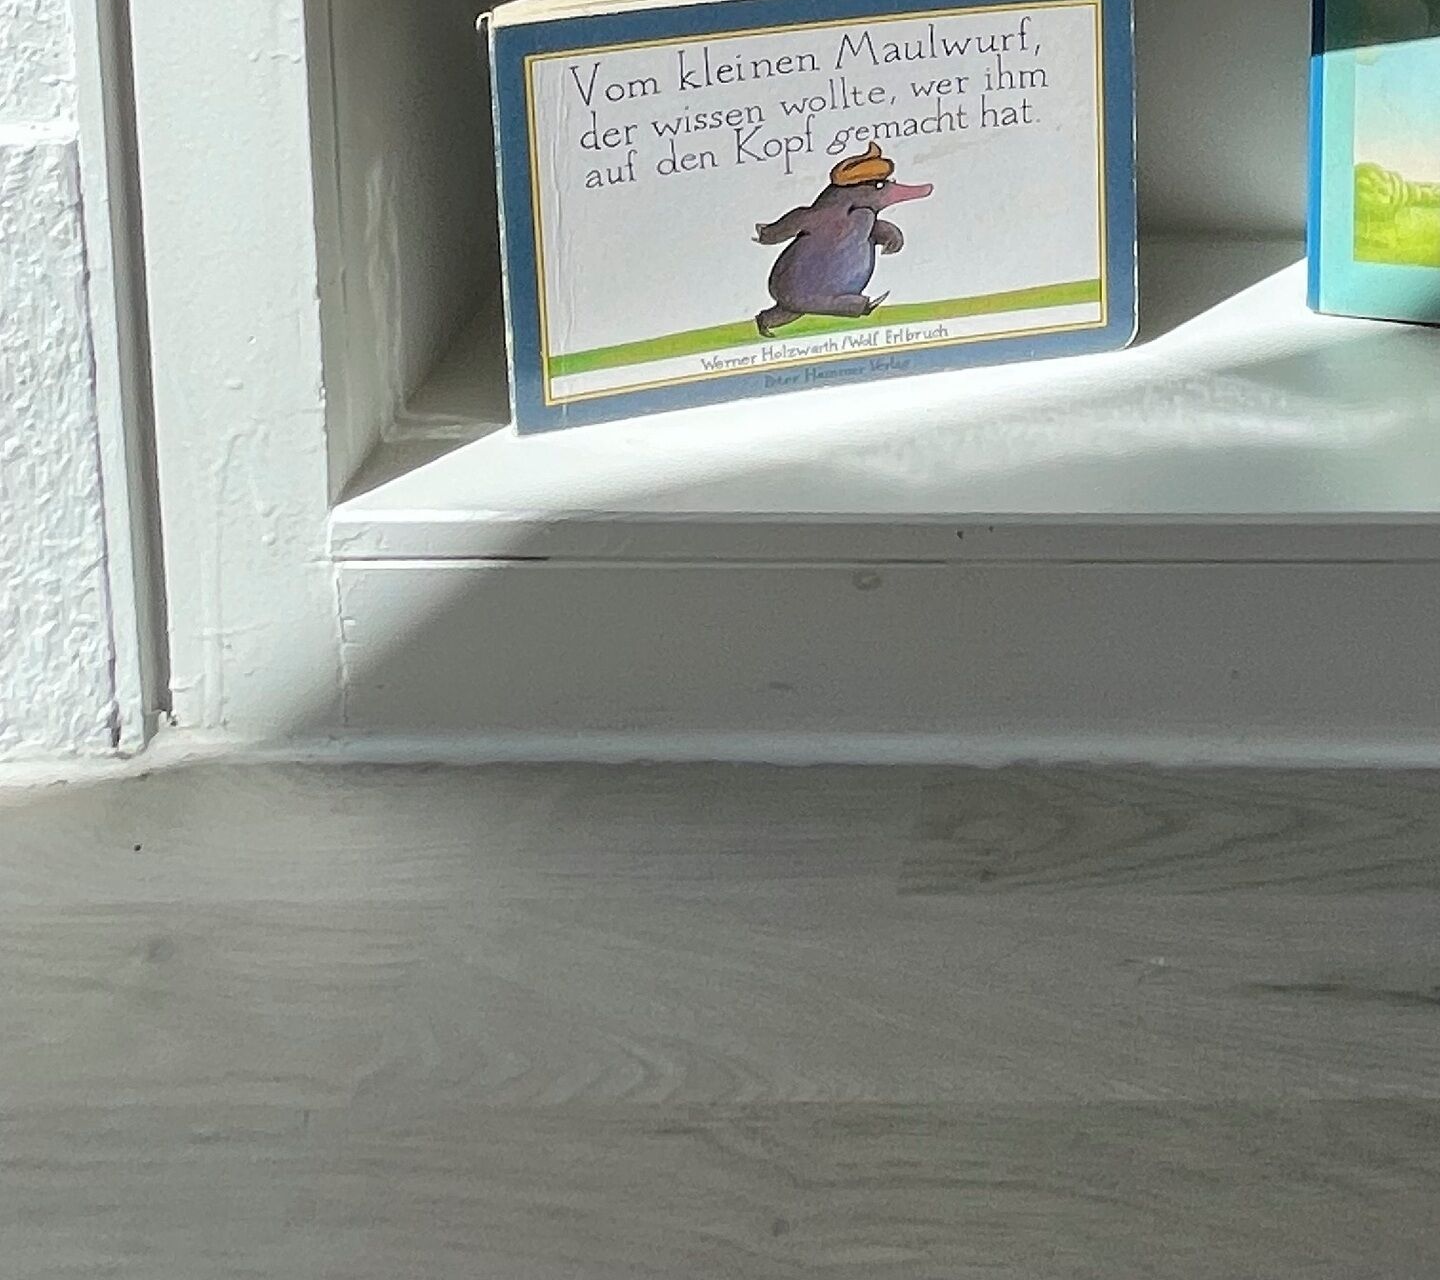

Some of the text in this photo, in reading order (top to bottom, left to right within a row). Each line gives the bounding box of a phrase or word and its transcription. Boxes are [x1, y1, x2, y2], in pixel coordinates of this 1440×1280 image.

[568, 16, 1041, 107] Vom kleinen Maulwurf,
[579, 54, 1049, 151] der wissen wollte, wer ihm
[584, 95, 1041, 190] auf den Kopf gemacht hat.
[700, 354, 757, 372] Werner
[761, 337, 838, 366] Holzwarth
[885, 323, 949, 345] Erlbruch
